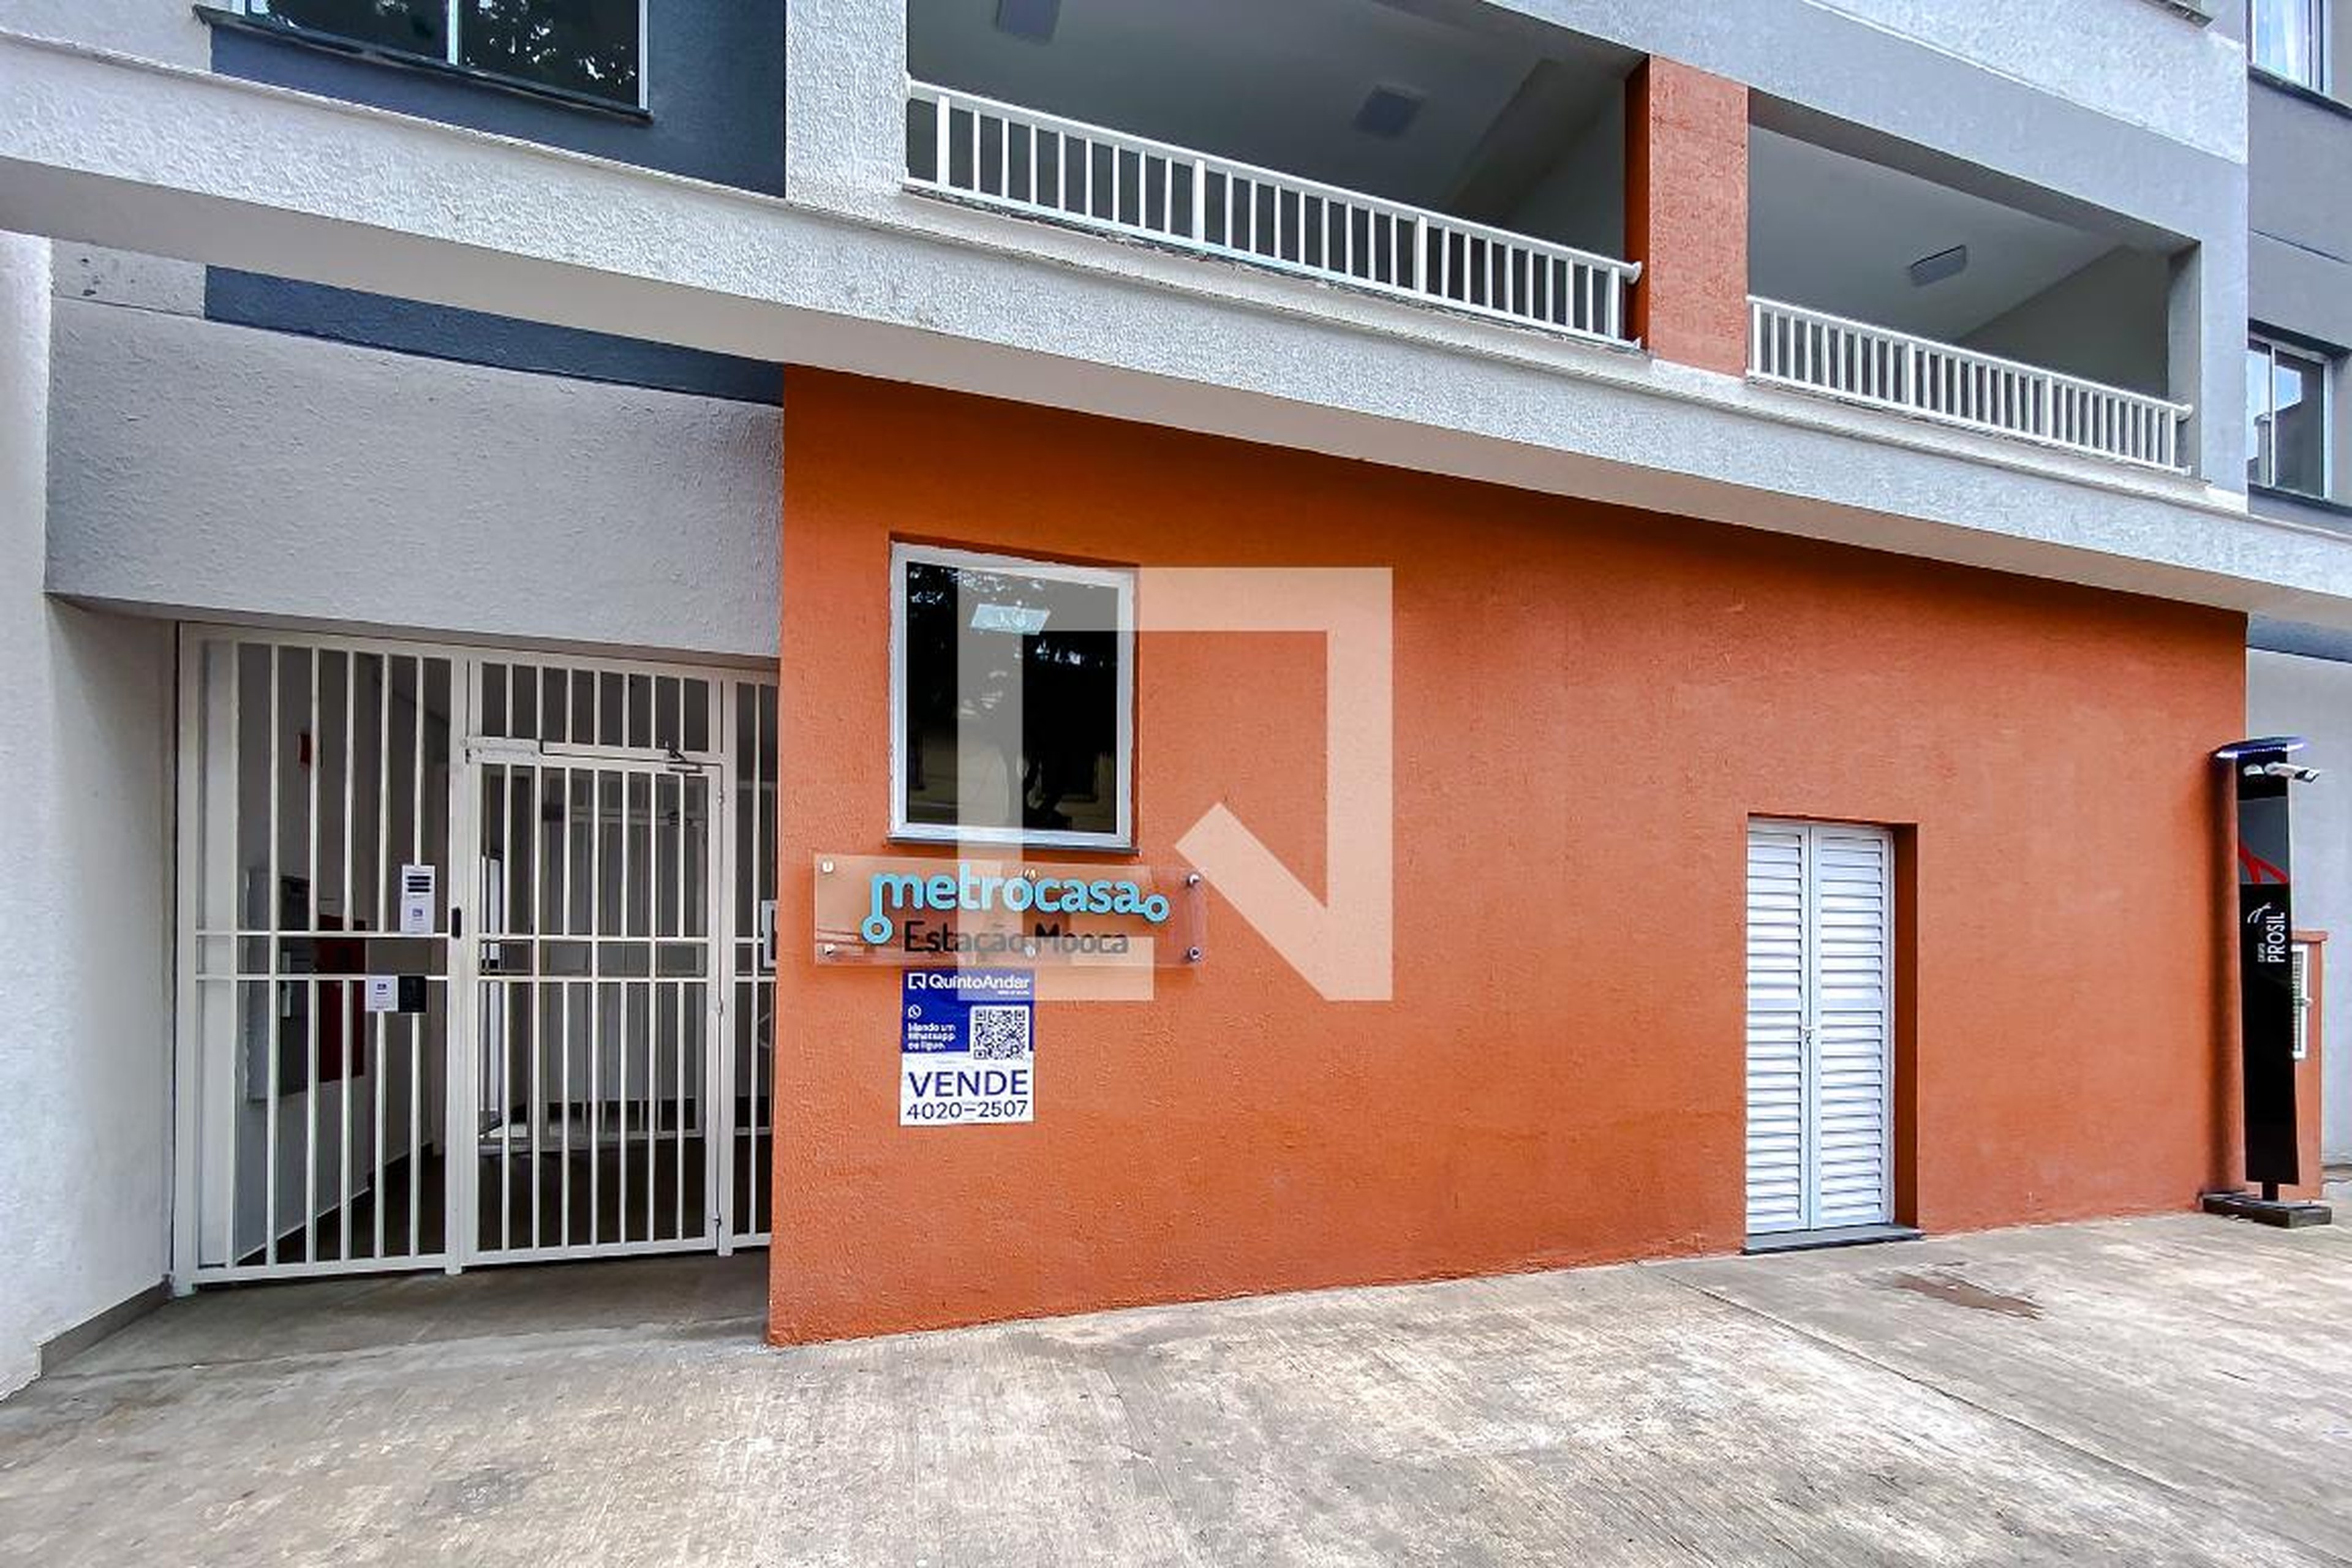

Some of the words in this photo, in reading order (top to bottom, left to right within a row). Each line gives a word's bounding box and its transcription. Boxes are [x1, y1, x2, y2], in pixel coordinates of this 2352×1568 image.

[861, 862, 1169, 944] metrocasa
[904, 920, 1025, 957] Estação
[1035, 922, 1129, 954] Mooca
[2266, 913, 2285, 962] PROSIL
[929, 973, 1030, 990] QuintoAndar
[908, 1070, 1028, 1097] VENDE
[907, 1100, 1028, 1119] 4020-2507
